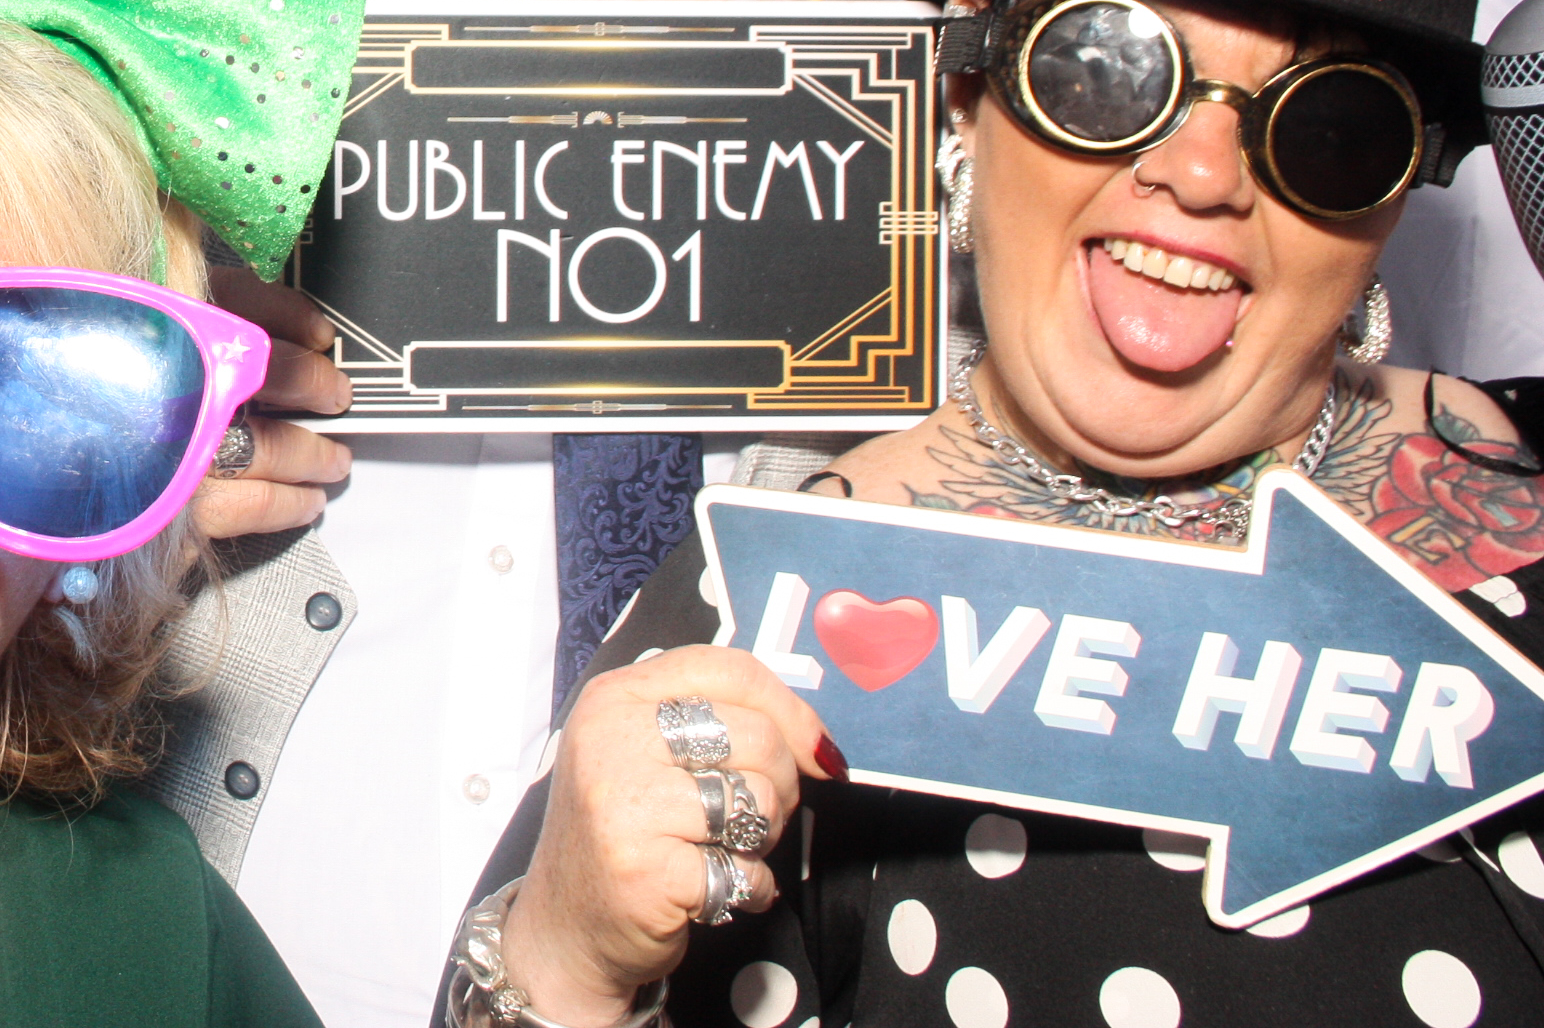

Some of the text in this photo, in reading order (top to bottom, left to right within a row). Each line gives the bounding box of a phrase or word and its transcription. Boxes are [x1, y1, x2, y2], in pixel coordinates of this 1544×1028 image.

[333, 139, 866, 222] PUBLIC ENEMY
[495, 226, 702, 324] NO1
[1171, 631, 1495, 789] HER
